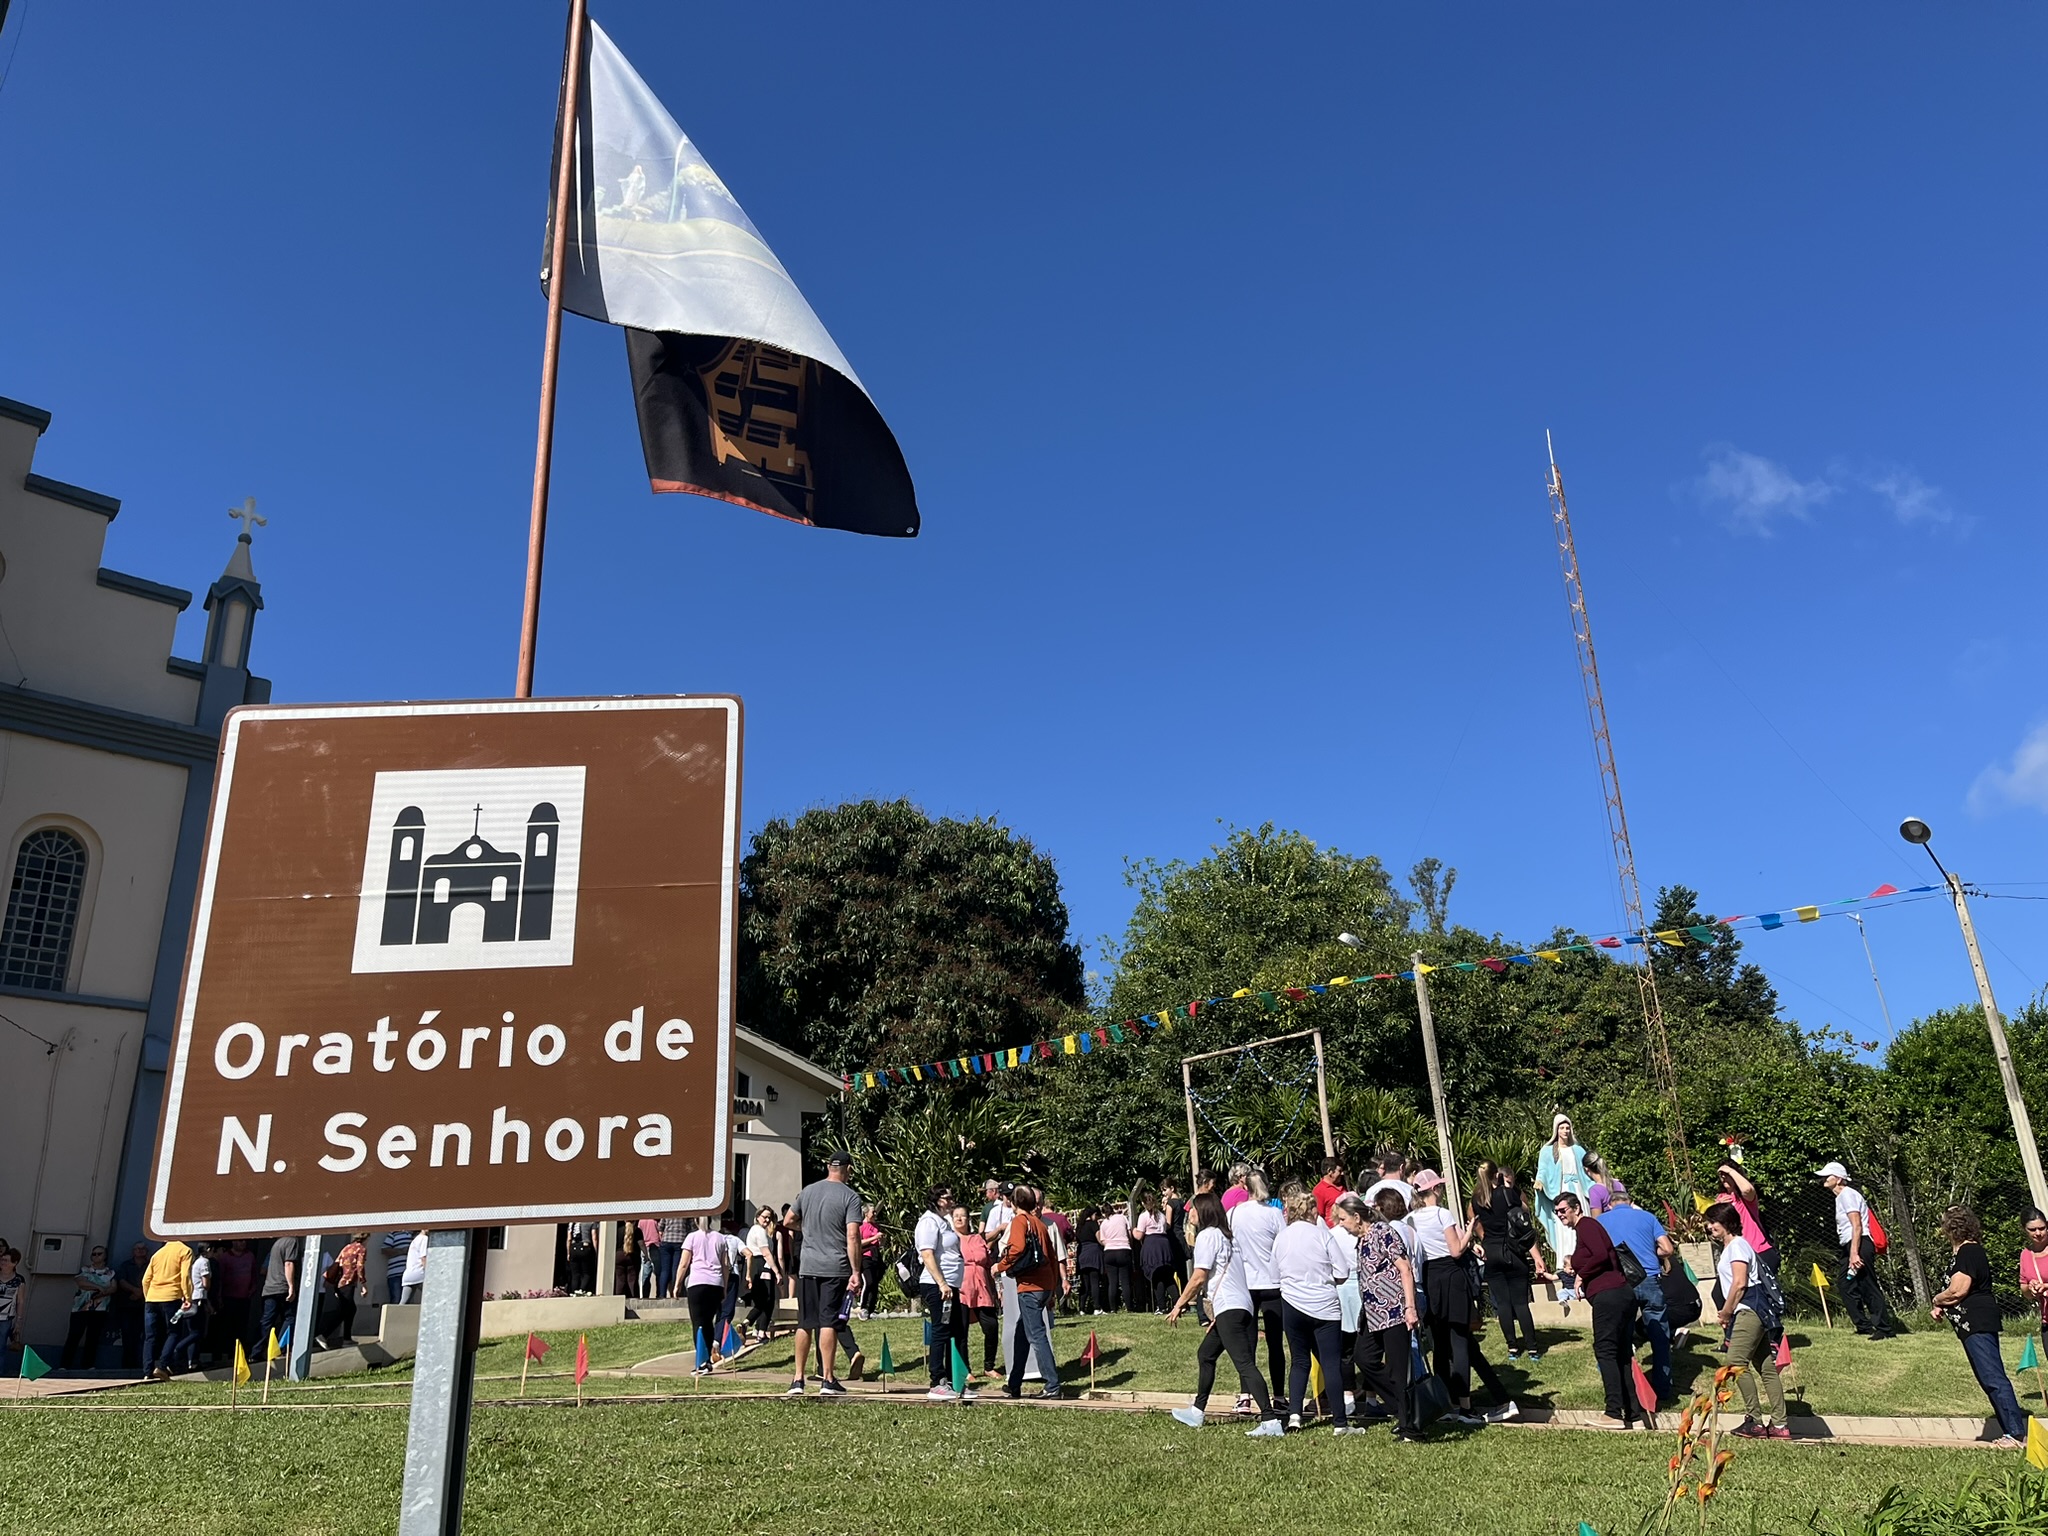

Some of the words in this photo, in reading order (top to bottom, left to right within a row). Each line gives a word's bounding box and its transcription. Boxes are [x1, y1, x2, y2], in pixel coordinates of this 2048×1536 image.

[214, 1009, 567, 1081] Oratório
[603, 1005, 695, 1062] de
[216, 1113, 288, 1175] N.
[317, 1105, 673, 1173] Senhora
